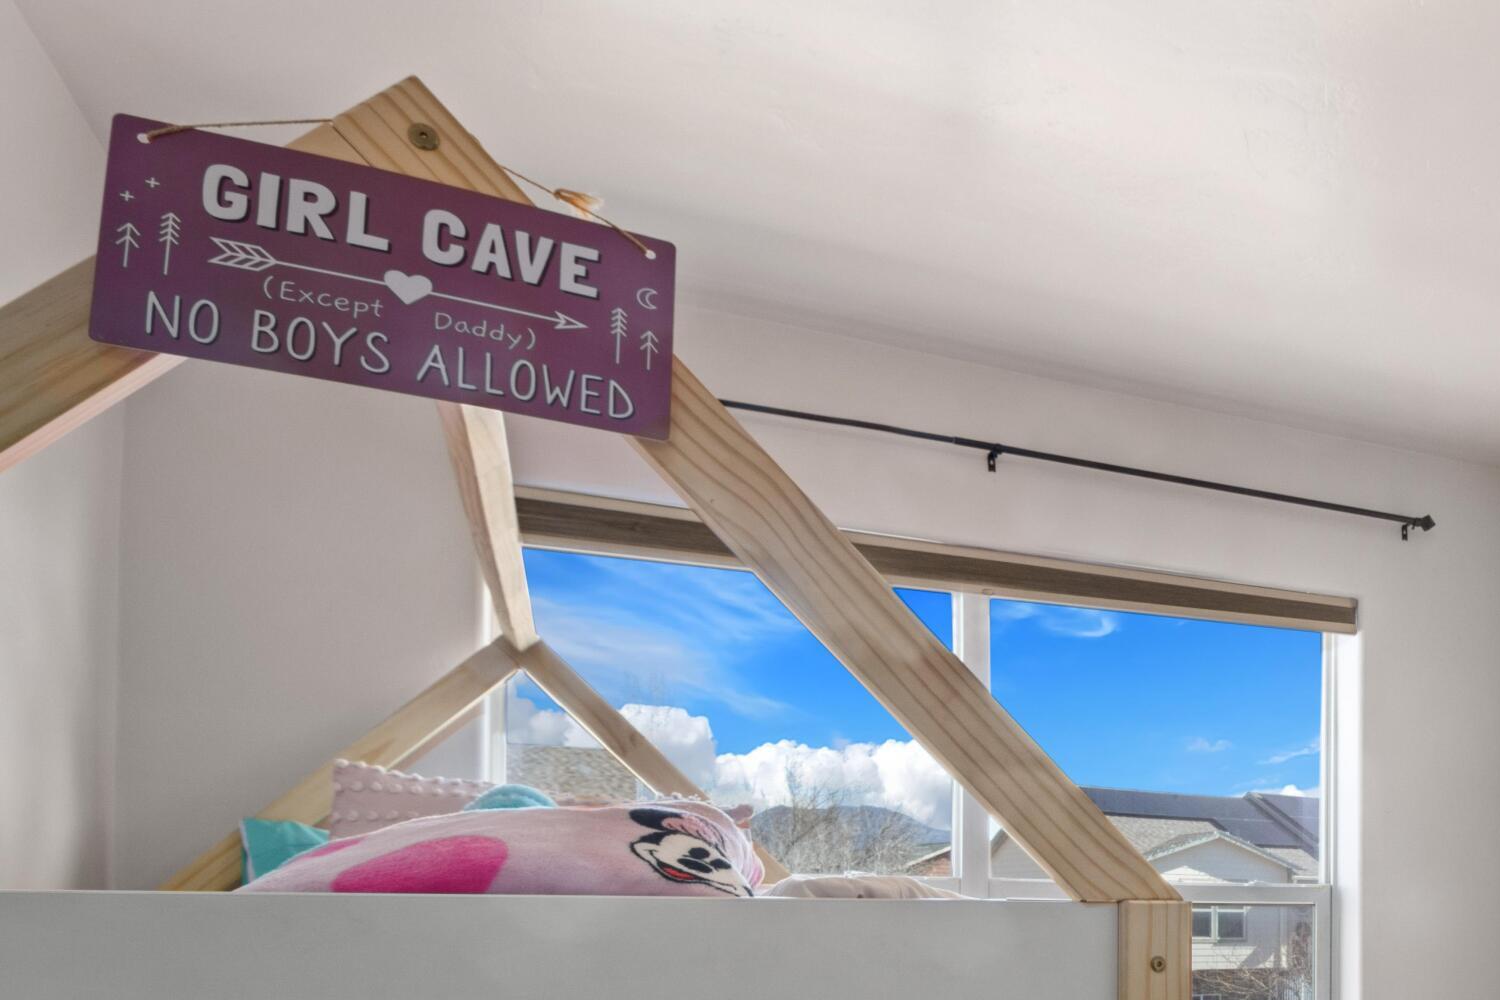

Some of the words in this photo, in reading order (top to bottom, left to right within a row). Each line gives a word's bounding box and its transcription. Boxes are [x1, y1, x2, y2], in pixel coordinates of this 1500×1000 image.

[203, 163, 390, 252] GIRL
[422, 208, 601, 299] CAVE
[145, 290, 220, 344] NO
[251, 309, 391, 373] BOYS
[416, 344, 635, 419] ALLOWED
[263, 275, 384, 319] (Except
[434, 311, 537, 351] Daddy)
